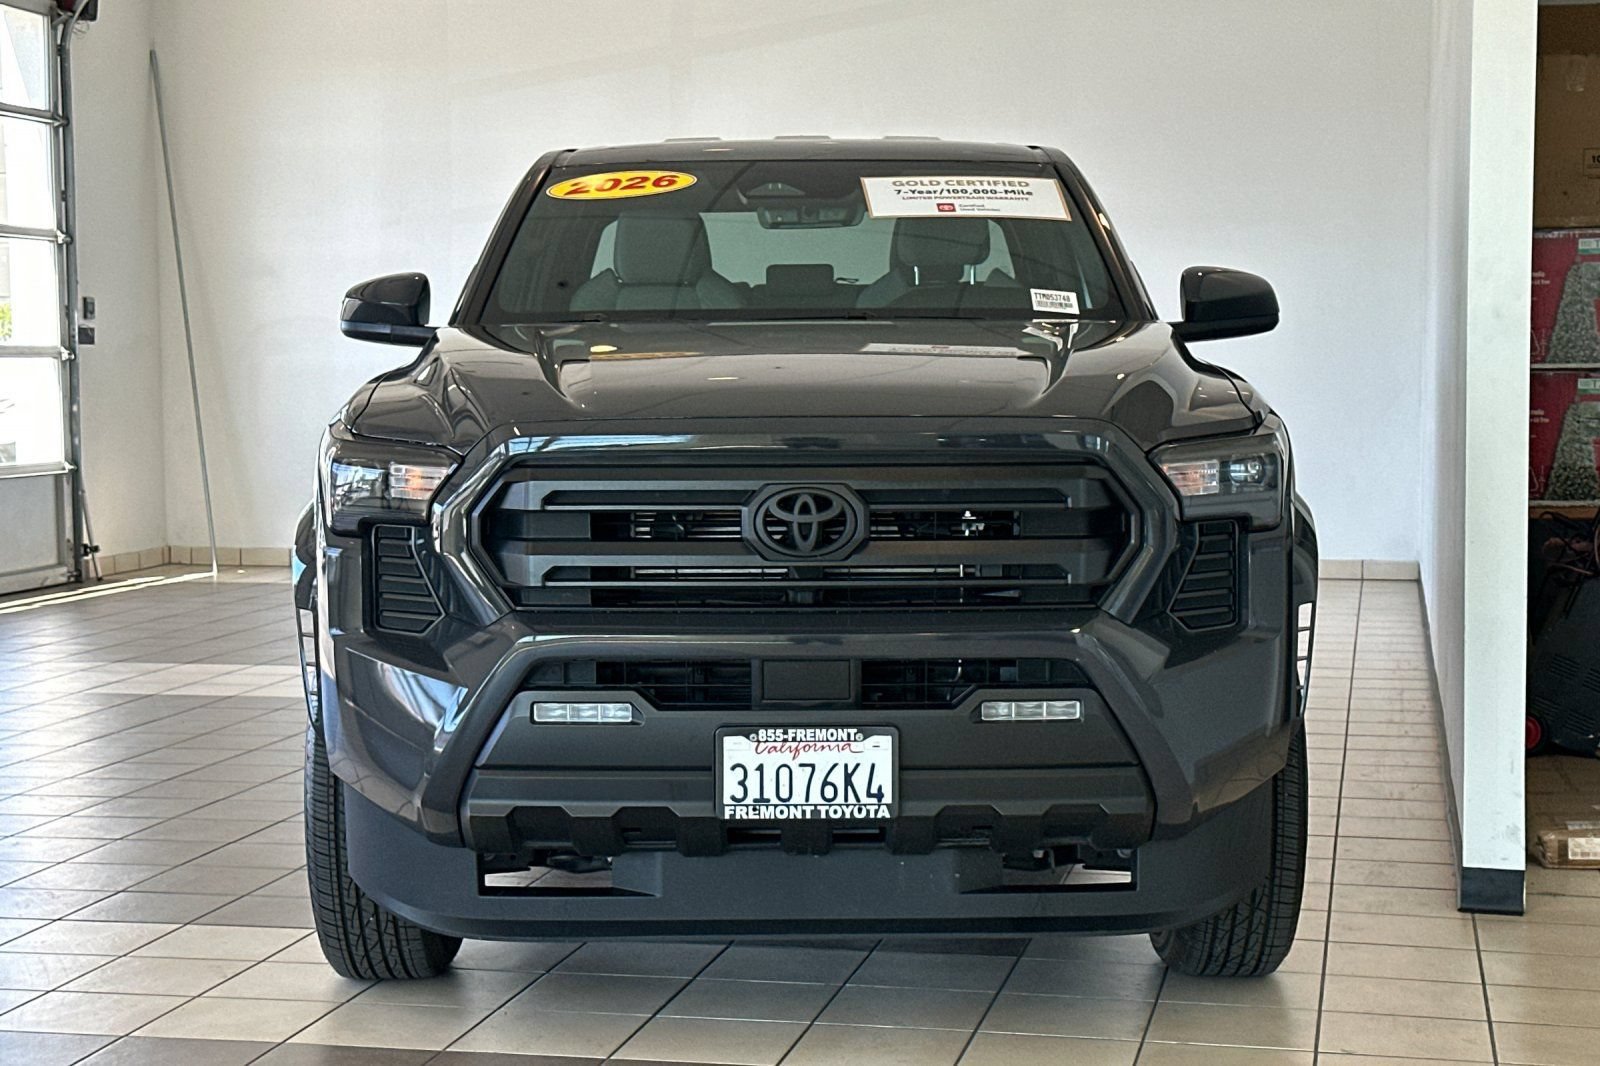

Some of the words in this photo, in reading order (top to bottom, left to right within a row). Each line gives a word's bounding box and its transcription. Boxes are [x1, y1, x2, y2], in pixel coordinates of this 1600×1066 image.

[564, 174, 680, 196] 2026
[892, 179, 941, 187] GOLD
[944, 179, 1030, 188] CERTIFIED
[894, 188, 1033, 197] 7-Year/100,000-Mile
[758, 728, 857, 742] 855-FREMONT
[754, 741, 864, 761] California
[729, 762, 885, 804] 31076K4
[724, 804, 816, 819] FREMONT
[816, 804, 891, 819] TOYOTA
